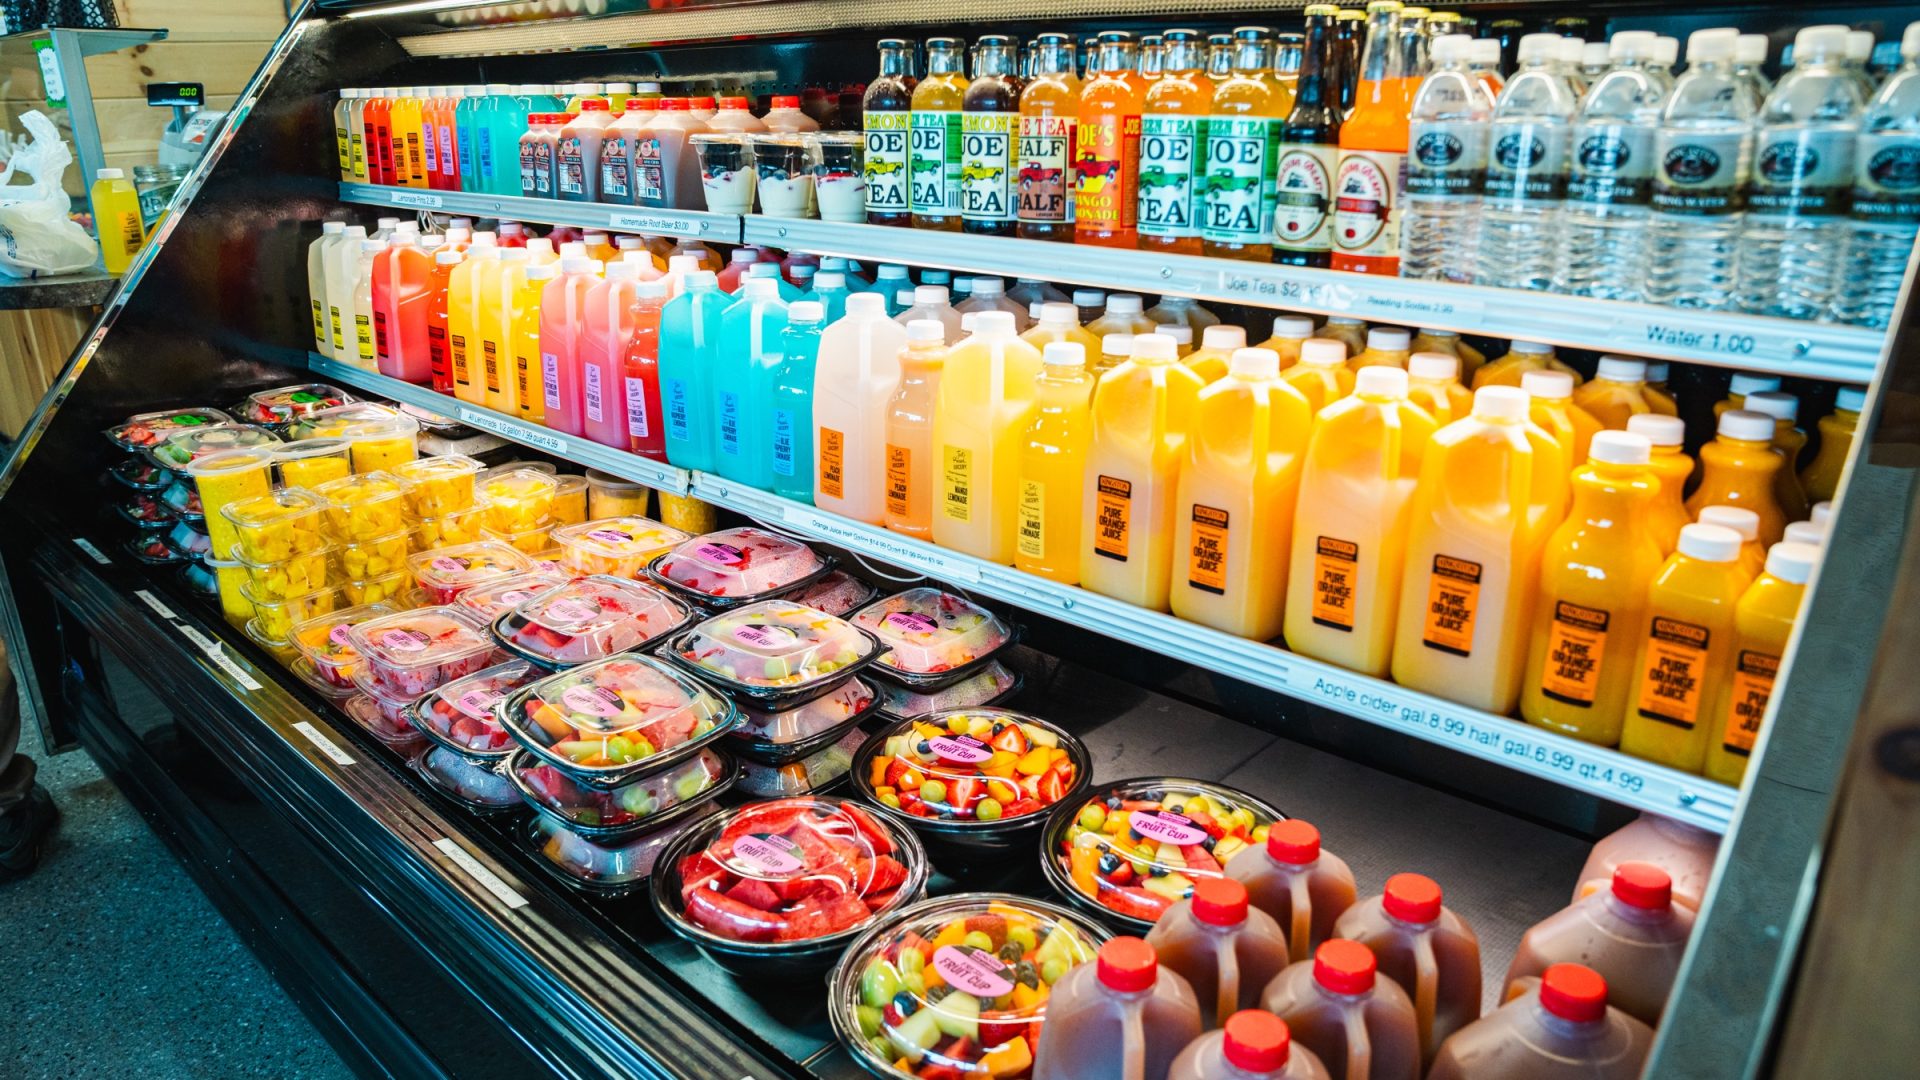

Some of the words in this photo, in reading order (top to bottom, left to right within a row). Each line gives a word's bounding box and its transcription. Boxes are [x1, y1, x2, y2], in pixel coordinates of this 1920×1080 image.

[922, 114, 944, 127] TEA
[1036, 119, 1067, 135] TEA
[1168, 120, 1194, 134] TEA
[1238, 121, 1265, 136] TEA
[912, 129, 941, 150] OE
[912, 183, 941, 204] EA
[620, 217, 648, 227] Homemade
[649, 219, 661, 228] Root
[661, 220, 674, 229] Beer
[674, 221, 689, 231] $3.00
[1226, 277, 1249, 292] Joe
[1253, 278, 1276, 295] Tea
[1367, 295, 1401, 309] Reading
[1647, 325, 1703, 347] Water
[1713, 333, 1755, 354] 1.00
[474, 415, 497, 429] Lemonade
[507, 425, 521, 437] gallon
[823, 471, 841, 483] LEMONADE
[829, 464, 840, 475] PEACH
[888, 489, 906, 502] LEMONADE
[894, 482, 907, 493] PEACH
[954, 485, 968, 496] MANGO
[947, 491, 968, 505] LEMONADE
[1103, 506, 1123, 519] PURE
[812, 519, 829, 530] Orange
[829, 527, 842, 535] Juice
[1026, 519, 1040, 530] MANGO
[1099, 515, 1127, 532] ORANGE
[1020, 527, 1040, 540] LEMONADE
[1101, 527, 1122, 541] JUICE
[1198, 536, 1219, 550] PURE
[1193, 546, 1223, 564] ORANGE
[1197, 559, 1218, 574] JUICE
[1323, 569, 1346, 586] PURE
[1317, 580, 1352, 599] ORANGE
[1321, 594, 1346, 610] JUICE
[1439, 591, 1467, 607] PURE
[1431, 601, 1472, 622] ORANGE
[1435, 618, 1463, 634] JUICE
[1560, 638, 1591, 656] PURE
[1552, 649, 1597, 671] ORANGE
[1659, 656, 1690, 676] PURE
[1555, 665, 1585, 683] JUICE
[1649, 668, 1696, 691] ORANGE
[1653, 685, 1687, 702] JUICE
[1313, 677, 1356, 702] Apple
[1359, 692, 1398, 713] cider
[1468, 725, 1502, 748] half
[933, 742, 958, 754] FRUIT
[957, 751, 977, 759] CUP
[1136, 819, 1168, 834] FRUIT
[1167, 829, 1189, 840] CUP
[738, 843, 766, 858] FRUIT
[762, 855, 783, 867] CUP
[938, 957, 971, 978] FRUIT
[967, 975, 991, 990] CUP
